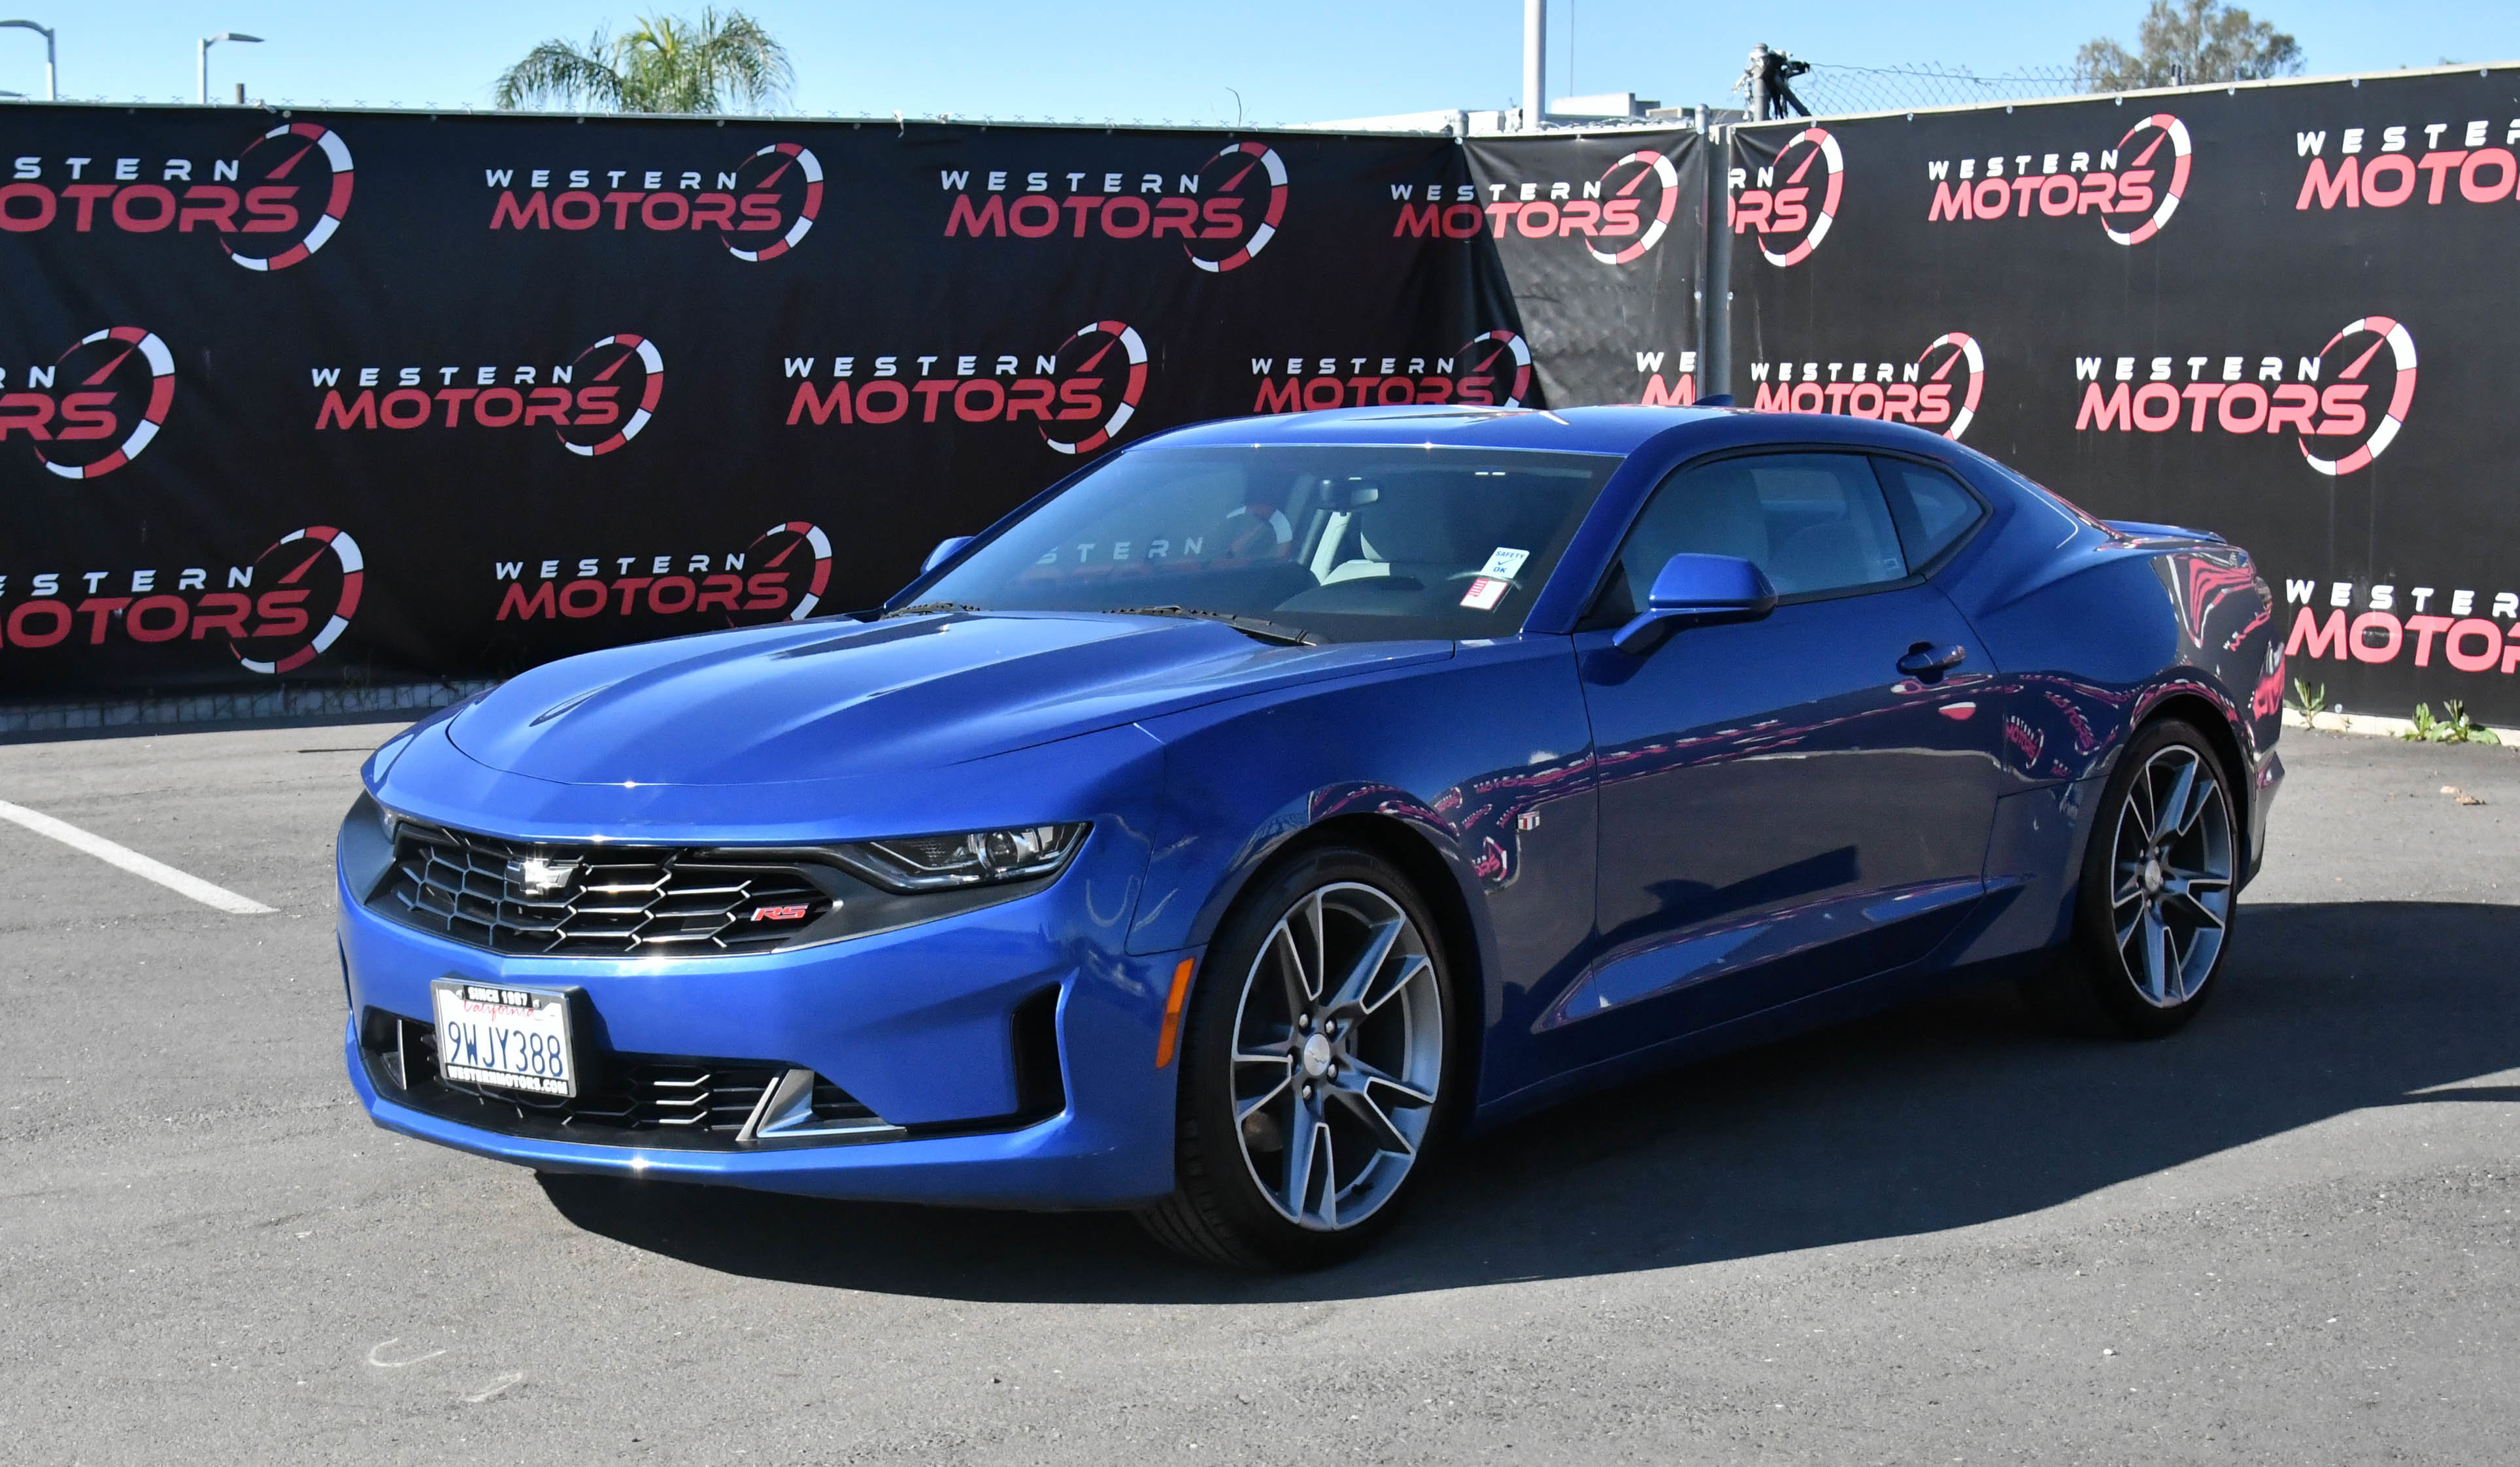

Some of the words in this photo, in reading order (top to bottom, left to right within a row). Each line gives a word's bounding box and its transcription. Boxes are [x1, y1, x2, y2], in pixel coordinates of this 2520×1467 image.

[2296, 119, 2520, 158] WESTE
[13, 157, 239, 181] STERN
[486, 169, 736, 190] WESTERN
[941, 171, 1198, 194] WESTERN
[1928, 149, 2119, 180] WESTERN
[2295, 147, 2520, 211] MOTO
[0, 183, 299, 233] OTORS
[1391, 179, 1602, 201] WESTERN
[1928, 169, 2155, 222] MOTORS
[490, 190, 782, 231] MOTORS
[945, 194, 1244, 239] MOTORS
[1393, 199, 1641, 239] MOTORS
[312, 365, 573, 387] WESTERN
[784, 355, 1056, 378] WESTERN
[1252, 358, 1454, 375] WESTERN
[1751, 362, 1919, 382] WESTERN
[2075, 356, 2322, 382] WESTERN
[316, 386, 620, 430] MOTORS
[786, 378, 1104, 426] MOTORS
[1254, 376, 1494, 414] MOTORS
[1753, 381, 1953, 424] MOTORS
[2074, 382, 2370, 435] MOTORS
[0, 566, 253, 596] STERN
[496, 553, 745, 580] WESTERN
[497, 572, 790, 620] MOTORS
[2285, 579, 2519, 618] WESTER
[0, 590, 311, 648] OTORS
[2284, 606, 2520, 675] MOTO
[751, 902, 811, 922] RS
[467, 986, 500, 1003] SINCE
[448, 1021, 563, 1077] 9WJY388
[447, 1065, 568, 1095] WESTERNMOTORS.COM
